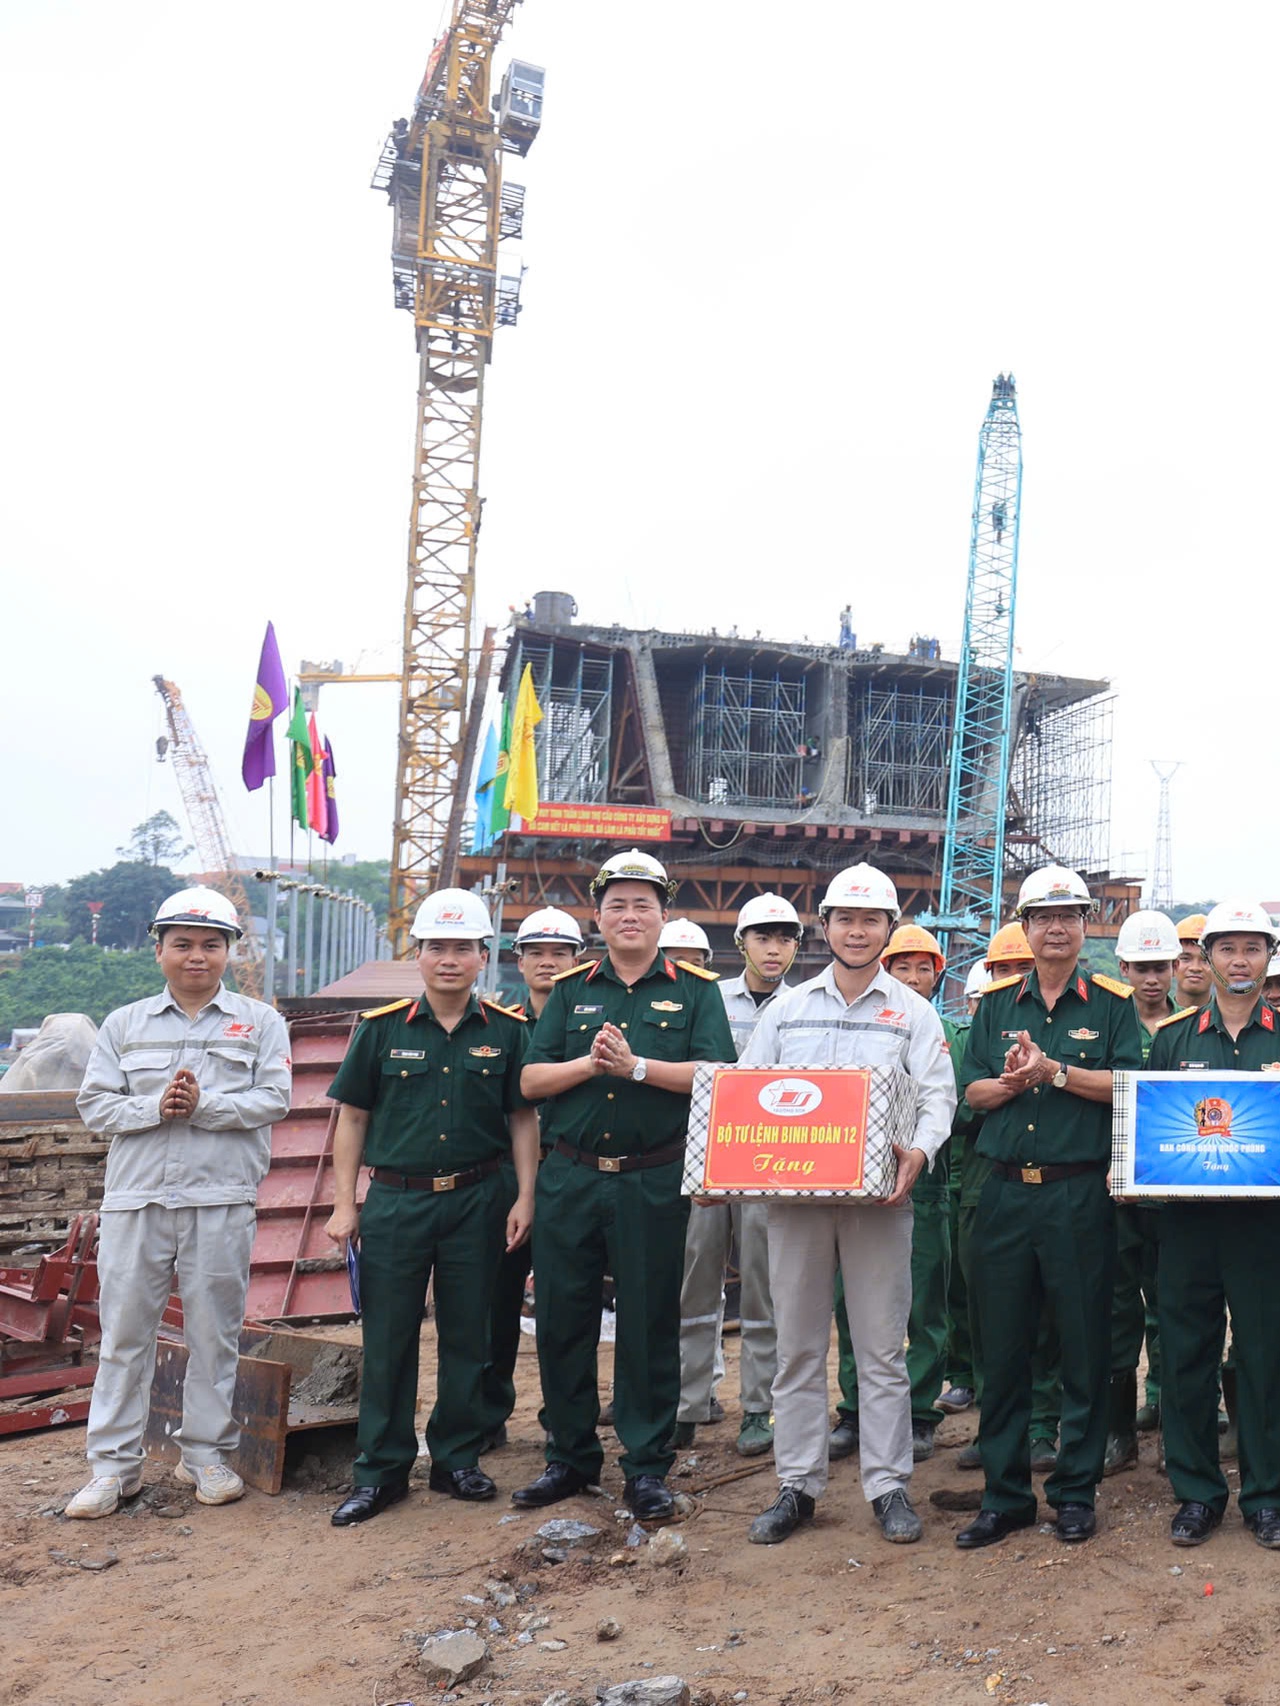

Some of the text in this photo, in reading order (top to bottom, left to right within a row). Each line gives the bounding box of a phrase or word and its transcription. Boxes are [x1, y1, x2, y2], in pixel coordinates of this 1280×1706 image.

[717, 1122, 857, 1147] BỘ TƯ LỆNH BINH ĐOÀN 12
[752, 1153, 816, 1175] Tặng
